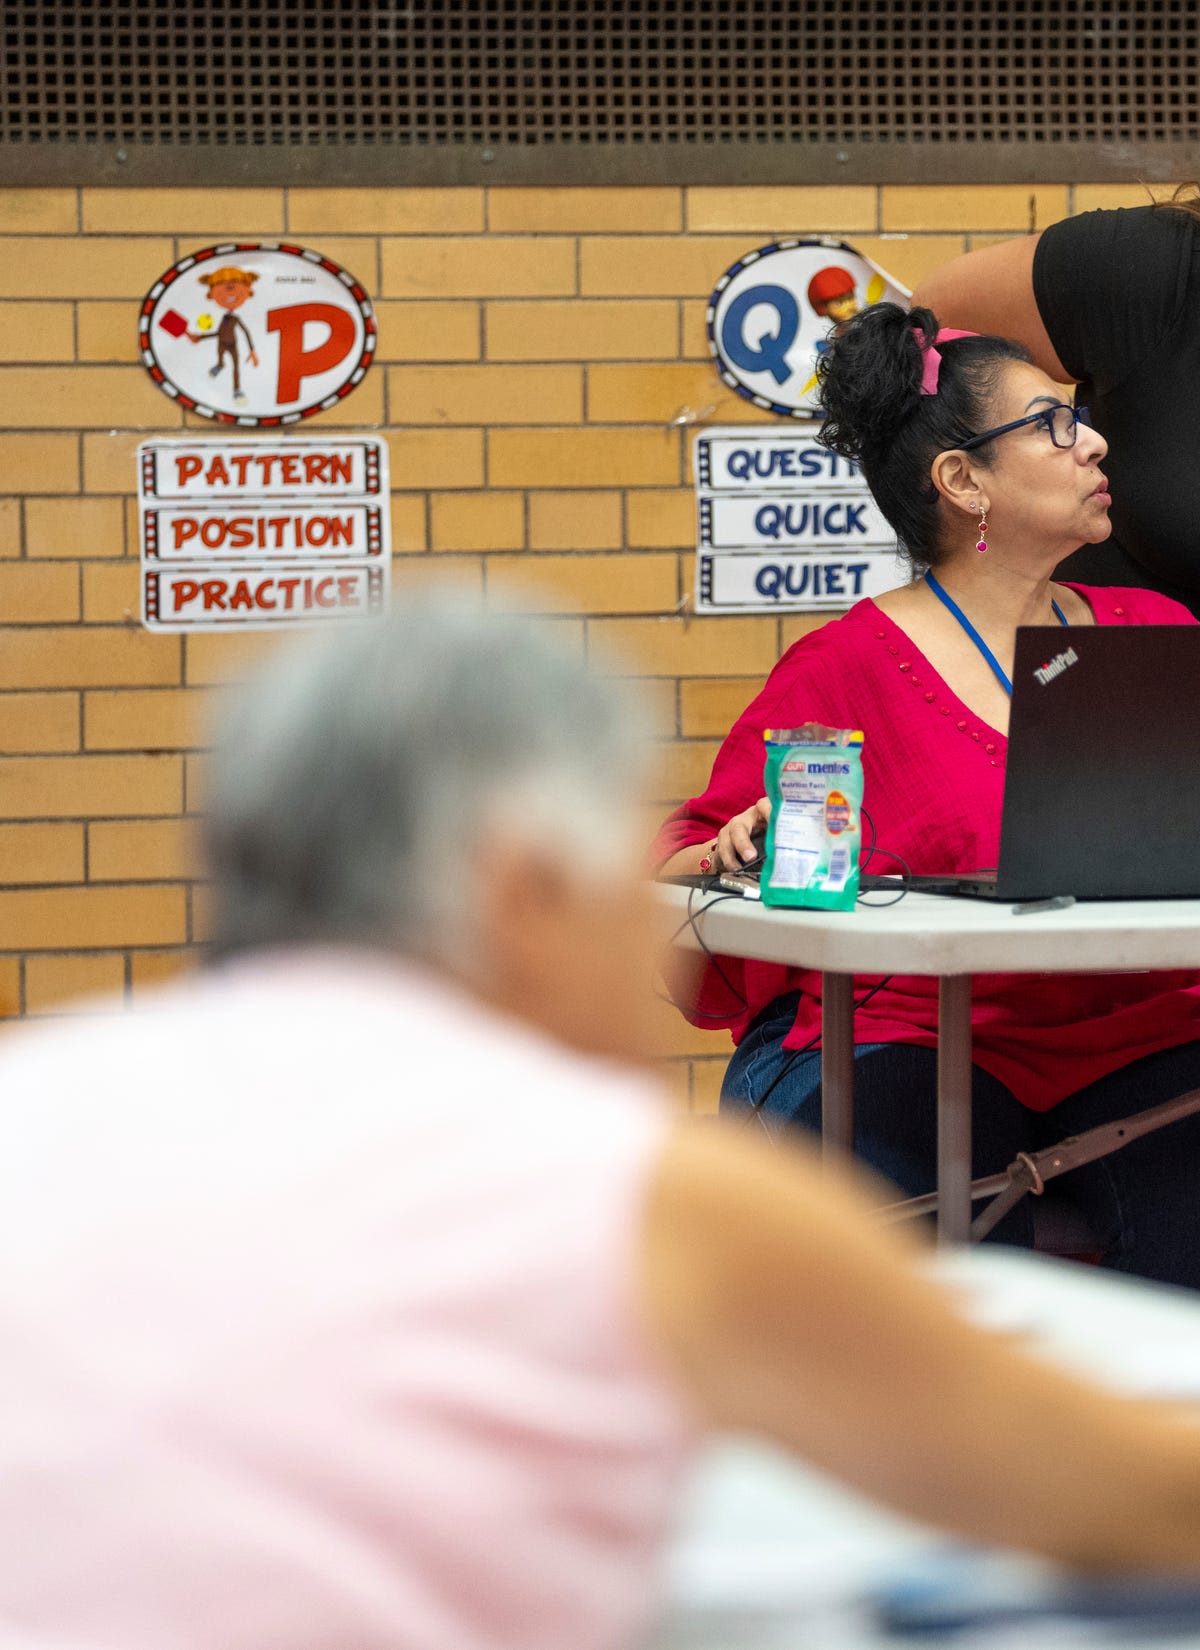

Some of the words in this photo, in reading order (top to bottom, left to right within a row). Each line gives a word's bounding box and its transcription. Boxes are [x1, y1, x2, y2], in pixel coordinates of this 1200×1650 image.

[722, 283, 800, 386] Q
[266, 302, 357, 405] P
[175, 453, 354, 489] PATTERN
[171, 515, 354, 550] POSITION
[754, 503, 868, 540] QUICK
[171, 575, 360, 613] PRACTICE
[754, 562, 870, 599] QUIET
[1033, 646, 1079, 685] ThinkPad
